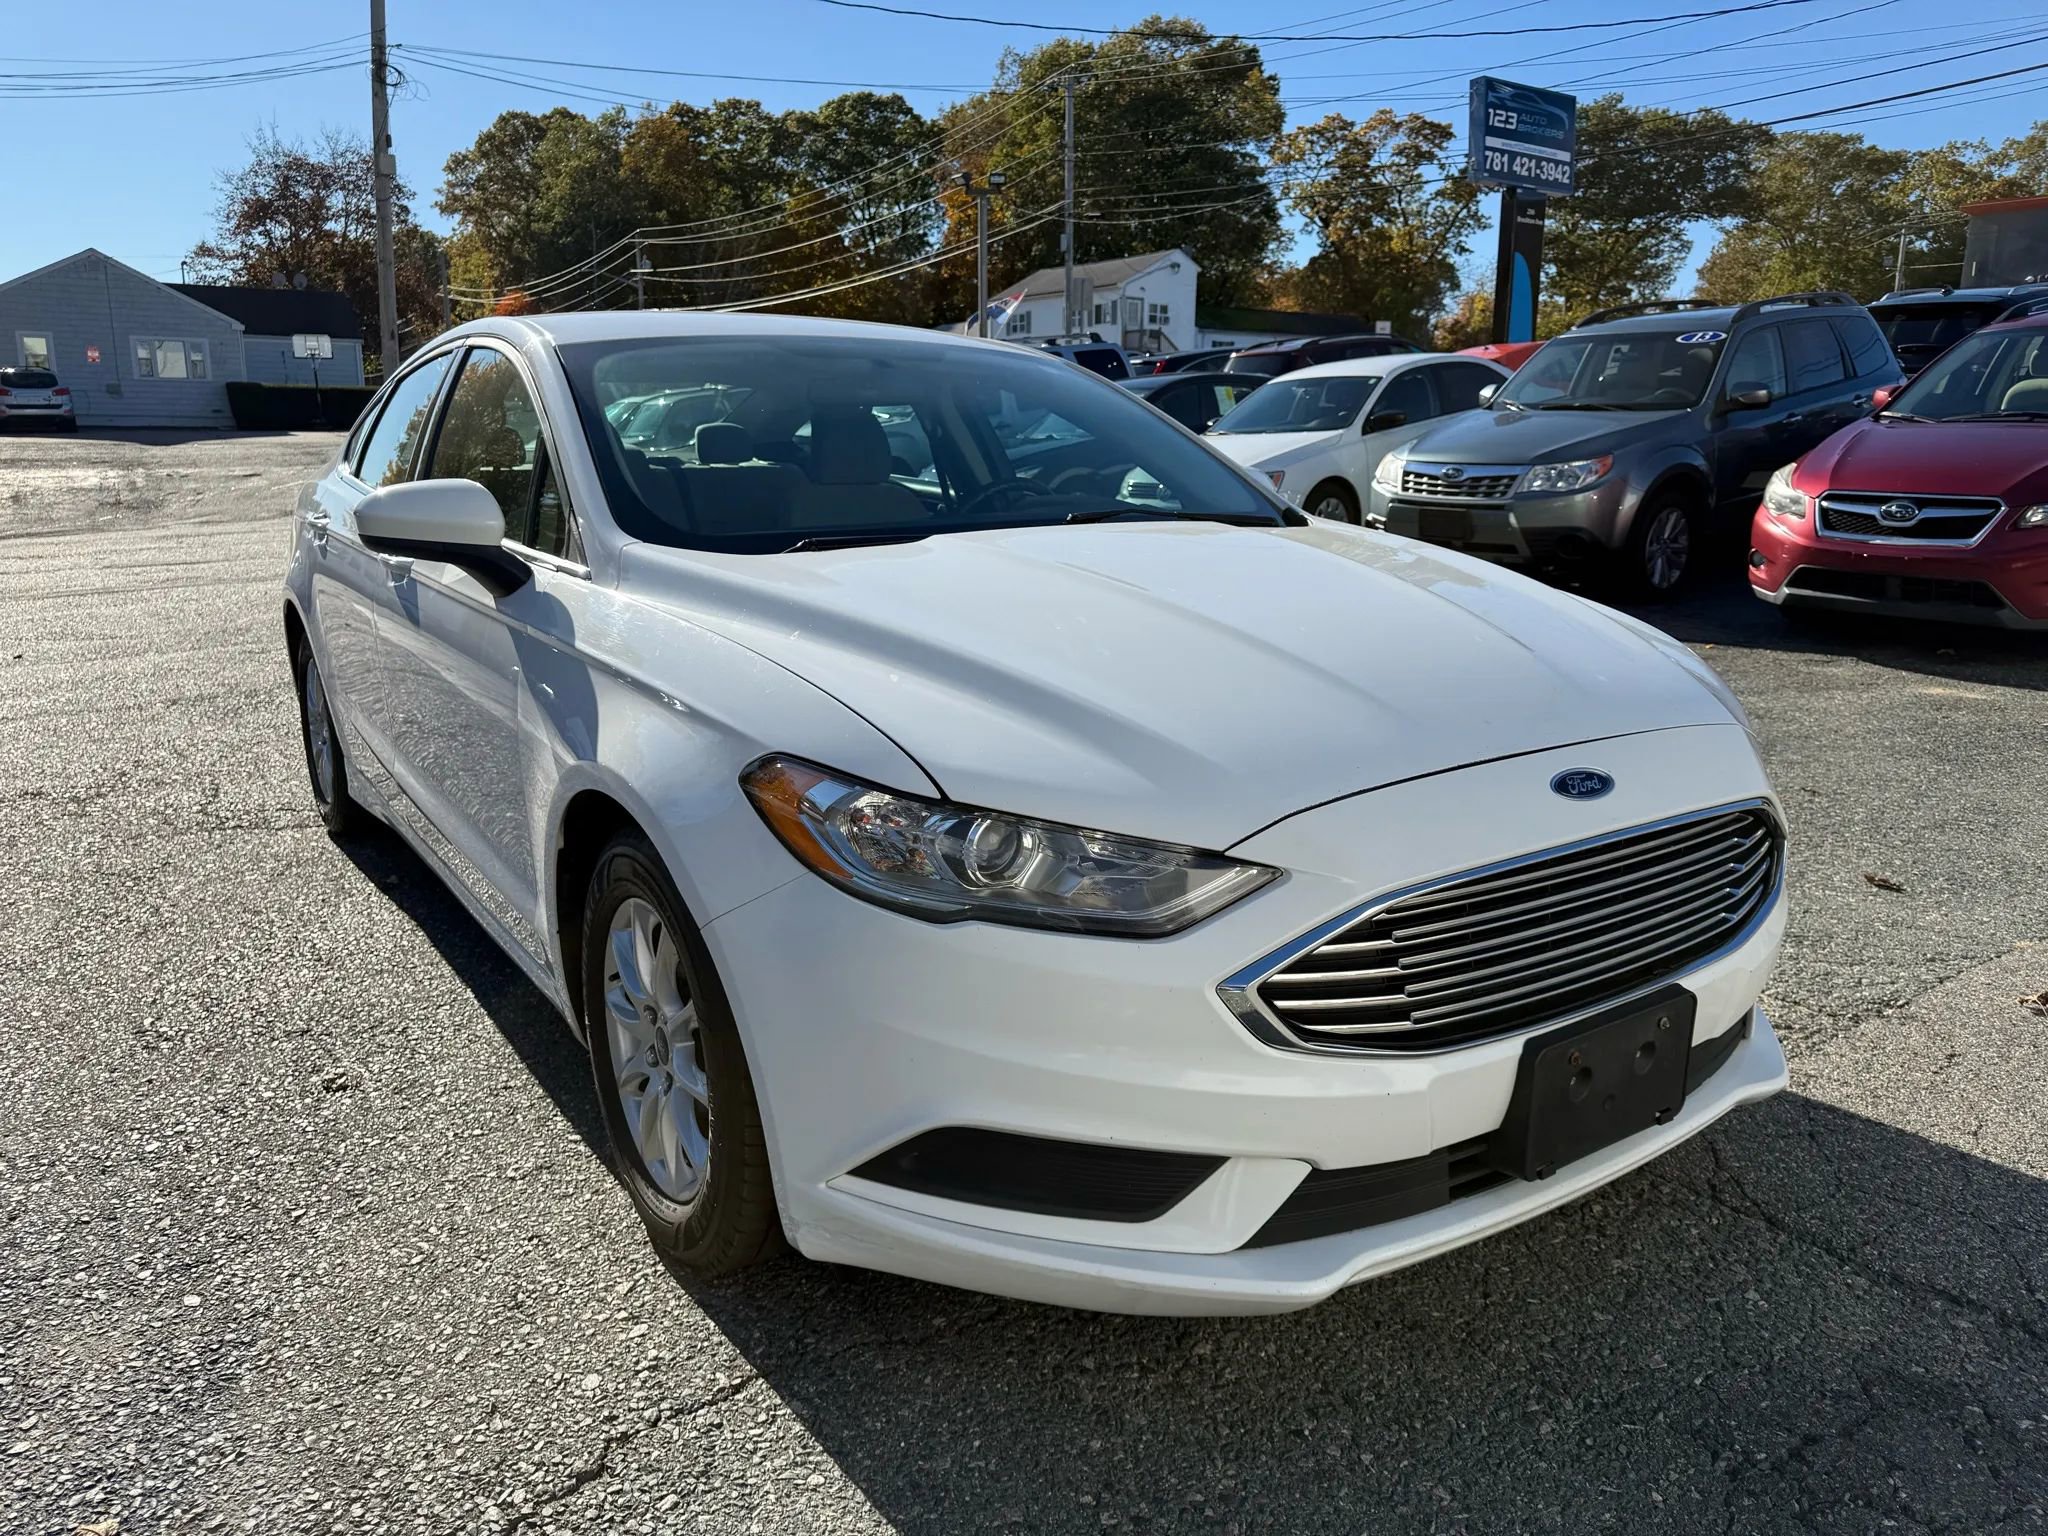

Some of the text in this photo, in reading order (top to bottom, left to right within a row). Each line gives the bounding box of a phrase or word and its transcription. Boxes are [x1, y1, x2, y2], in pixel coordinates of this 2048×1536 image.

[1488, 108, 1548, 130] 123 AUTO
[1517, 123, 1565, 140] BROKERS
[1484, 150, 1509, 173] 781
[1512, 155, 1571, 184] 421-3942
[1566, 773, 1602, 794] Ford
